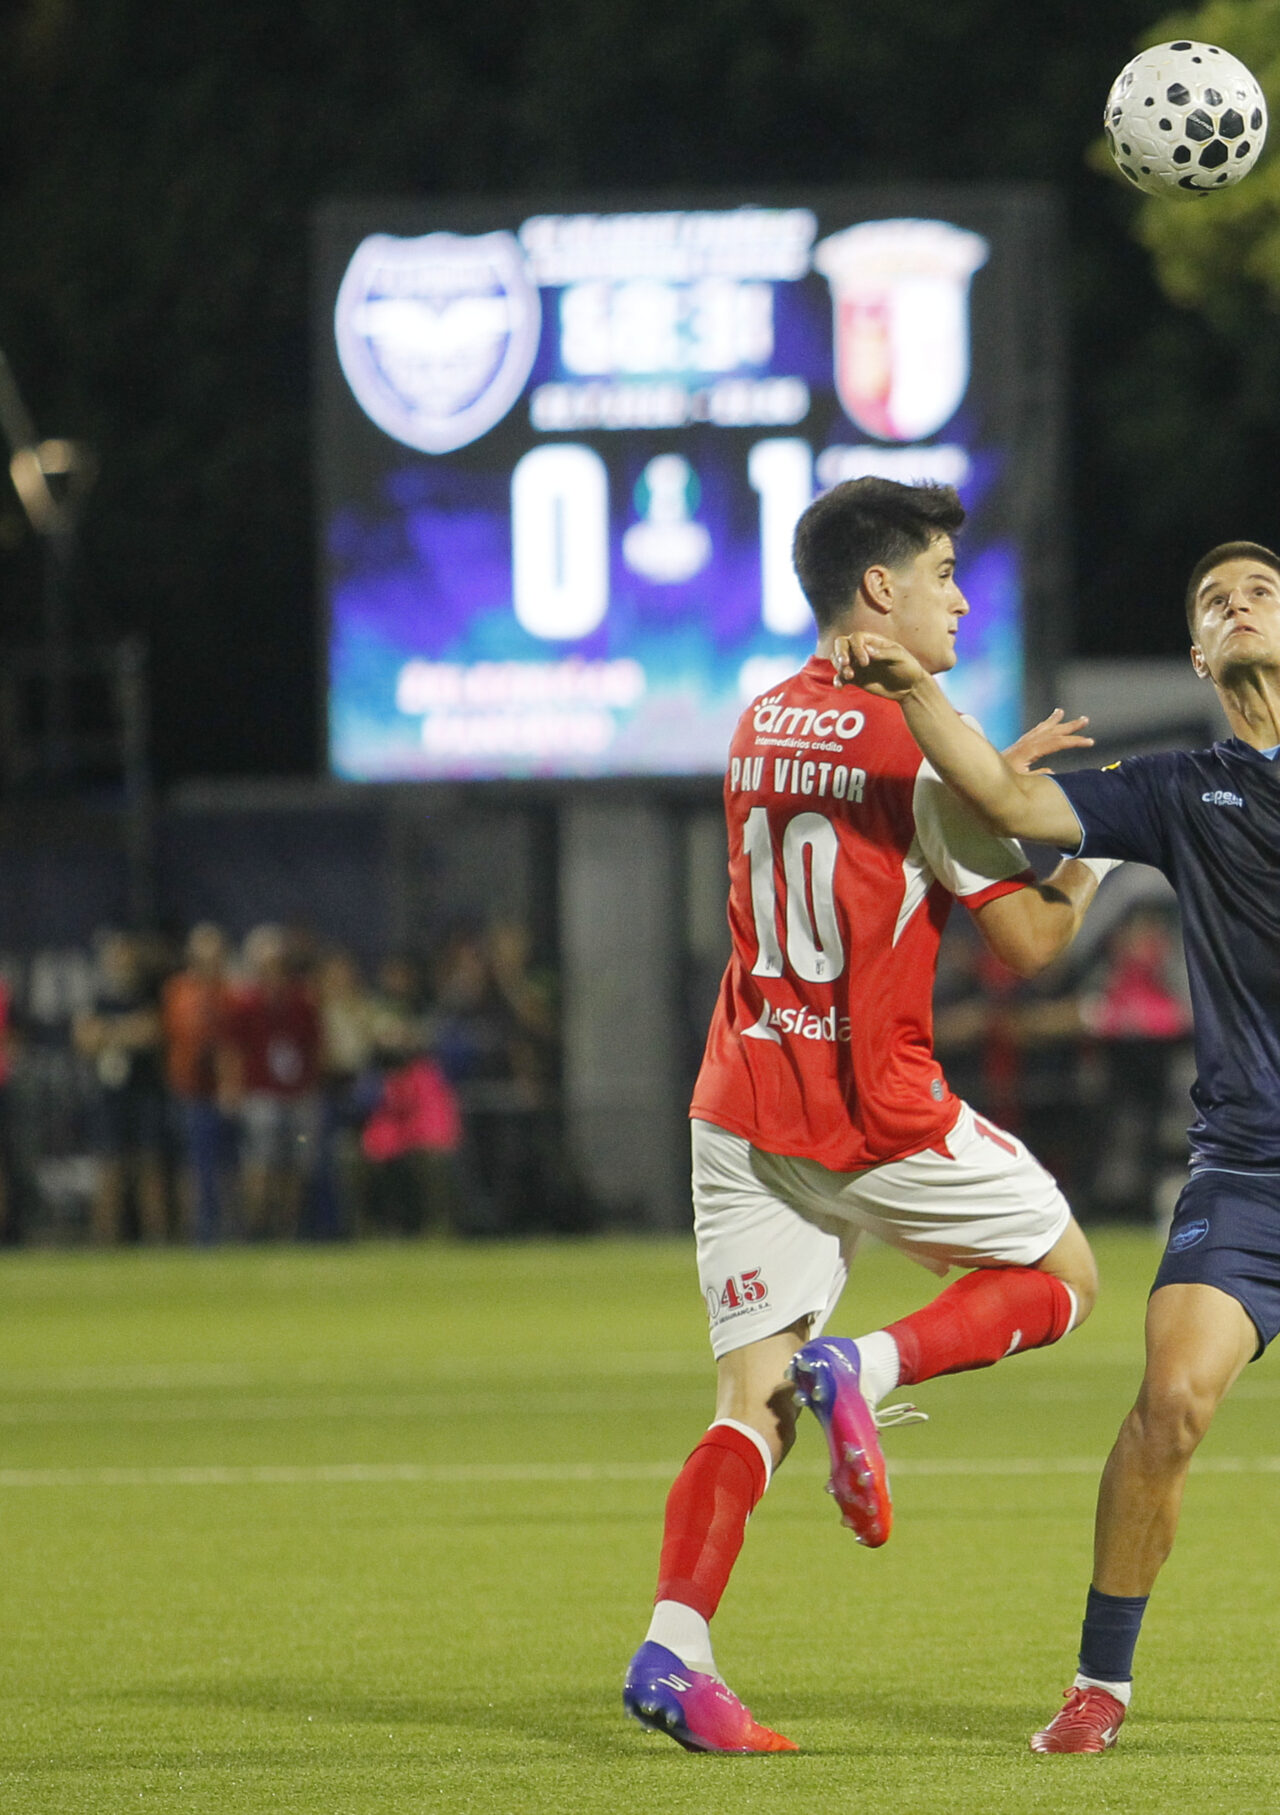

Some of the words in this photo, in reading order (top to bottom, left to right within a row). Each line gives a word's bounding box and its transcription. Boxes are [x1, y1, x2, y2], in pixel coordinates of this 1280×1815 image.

[512, 444, 609, 640] 0
[748, 437, 818, 635] 1
[730, 756, 765, 792] PAU
[774, 750, 867, 803] VÍCTOR
[754, 735, 810, 750] intermediários
[811, 739, 844, 753] crédito
[743, 807, 845, 983] 10
